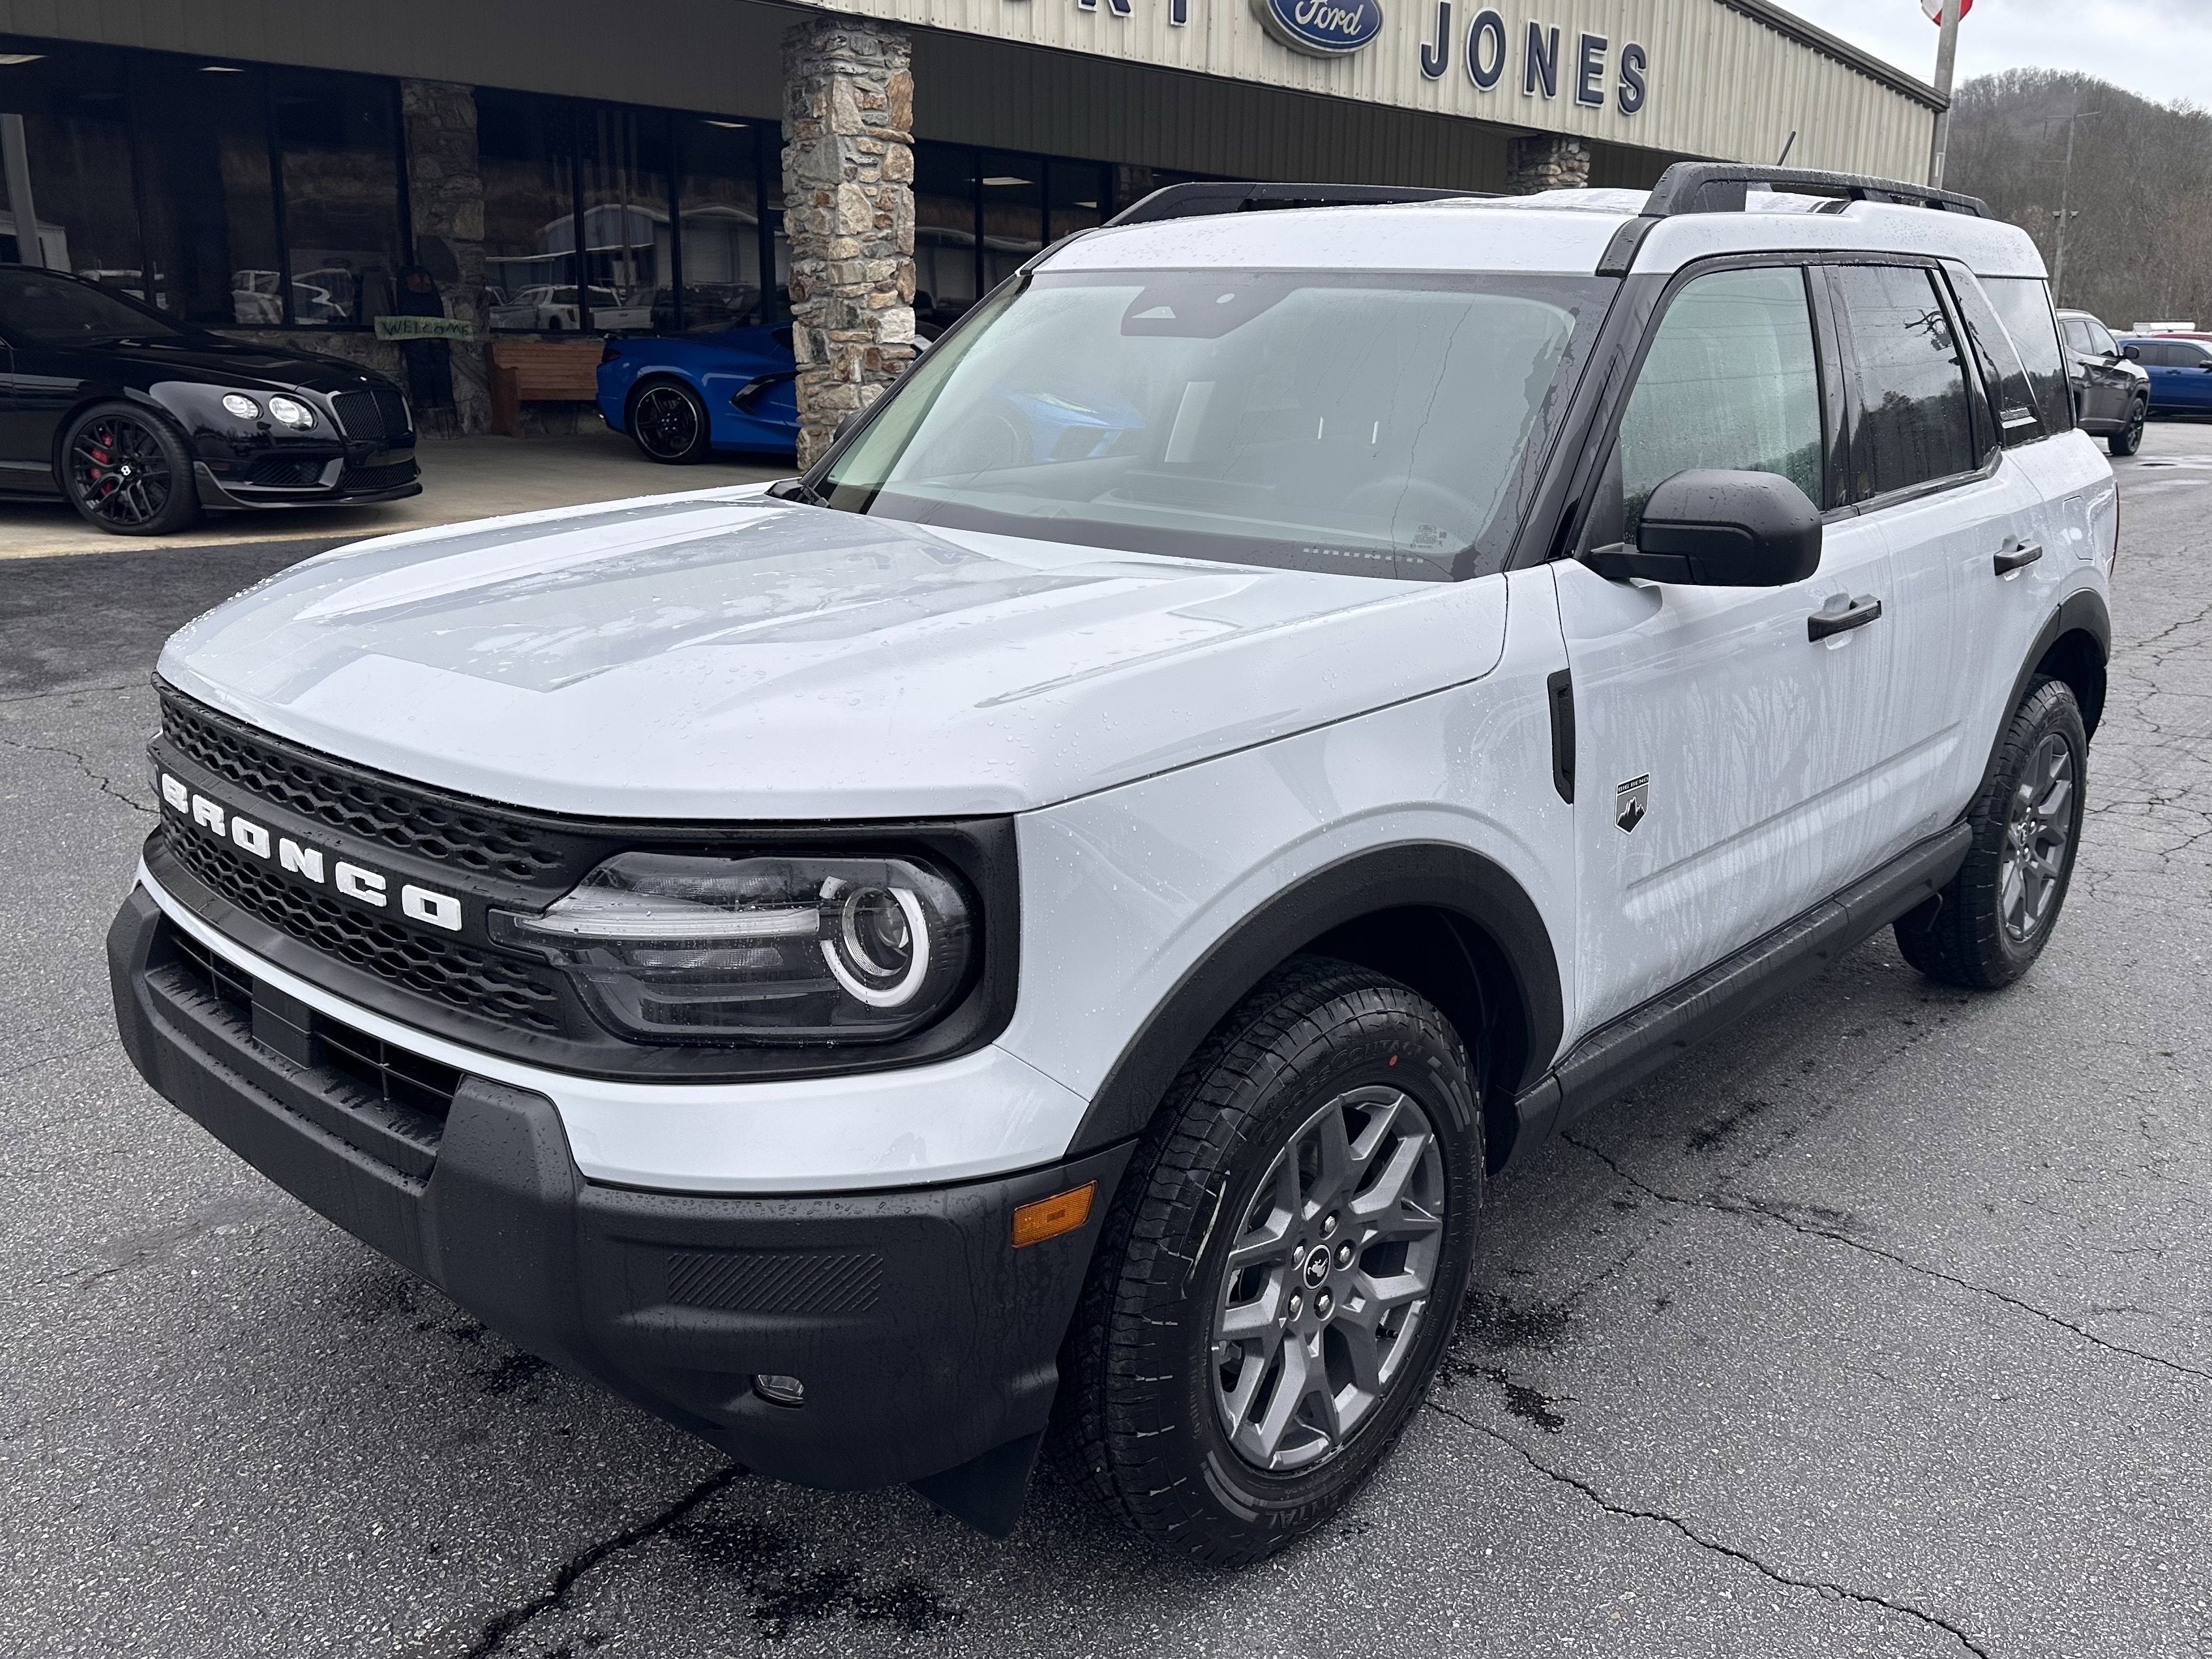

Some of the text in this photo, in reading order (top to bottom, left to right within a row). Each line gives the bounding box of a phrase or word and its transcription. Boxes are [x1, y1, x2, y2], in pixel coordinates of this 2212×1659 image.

[1294, 0, 1364, 35] Ford
[1420, 1, 1647, 115] JONES
[381, 320, 470, 337] WELCOME
[161, 772, 462, 931] BRONCO
